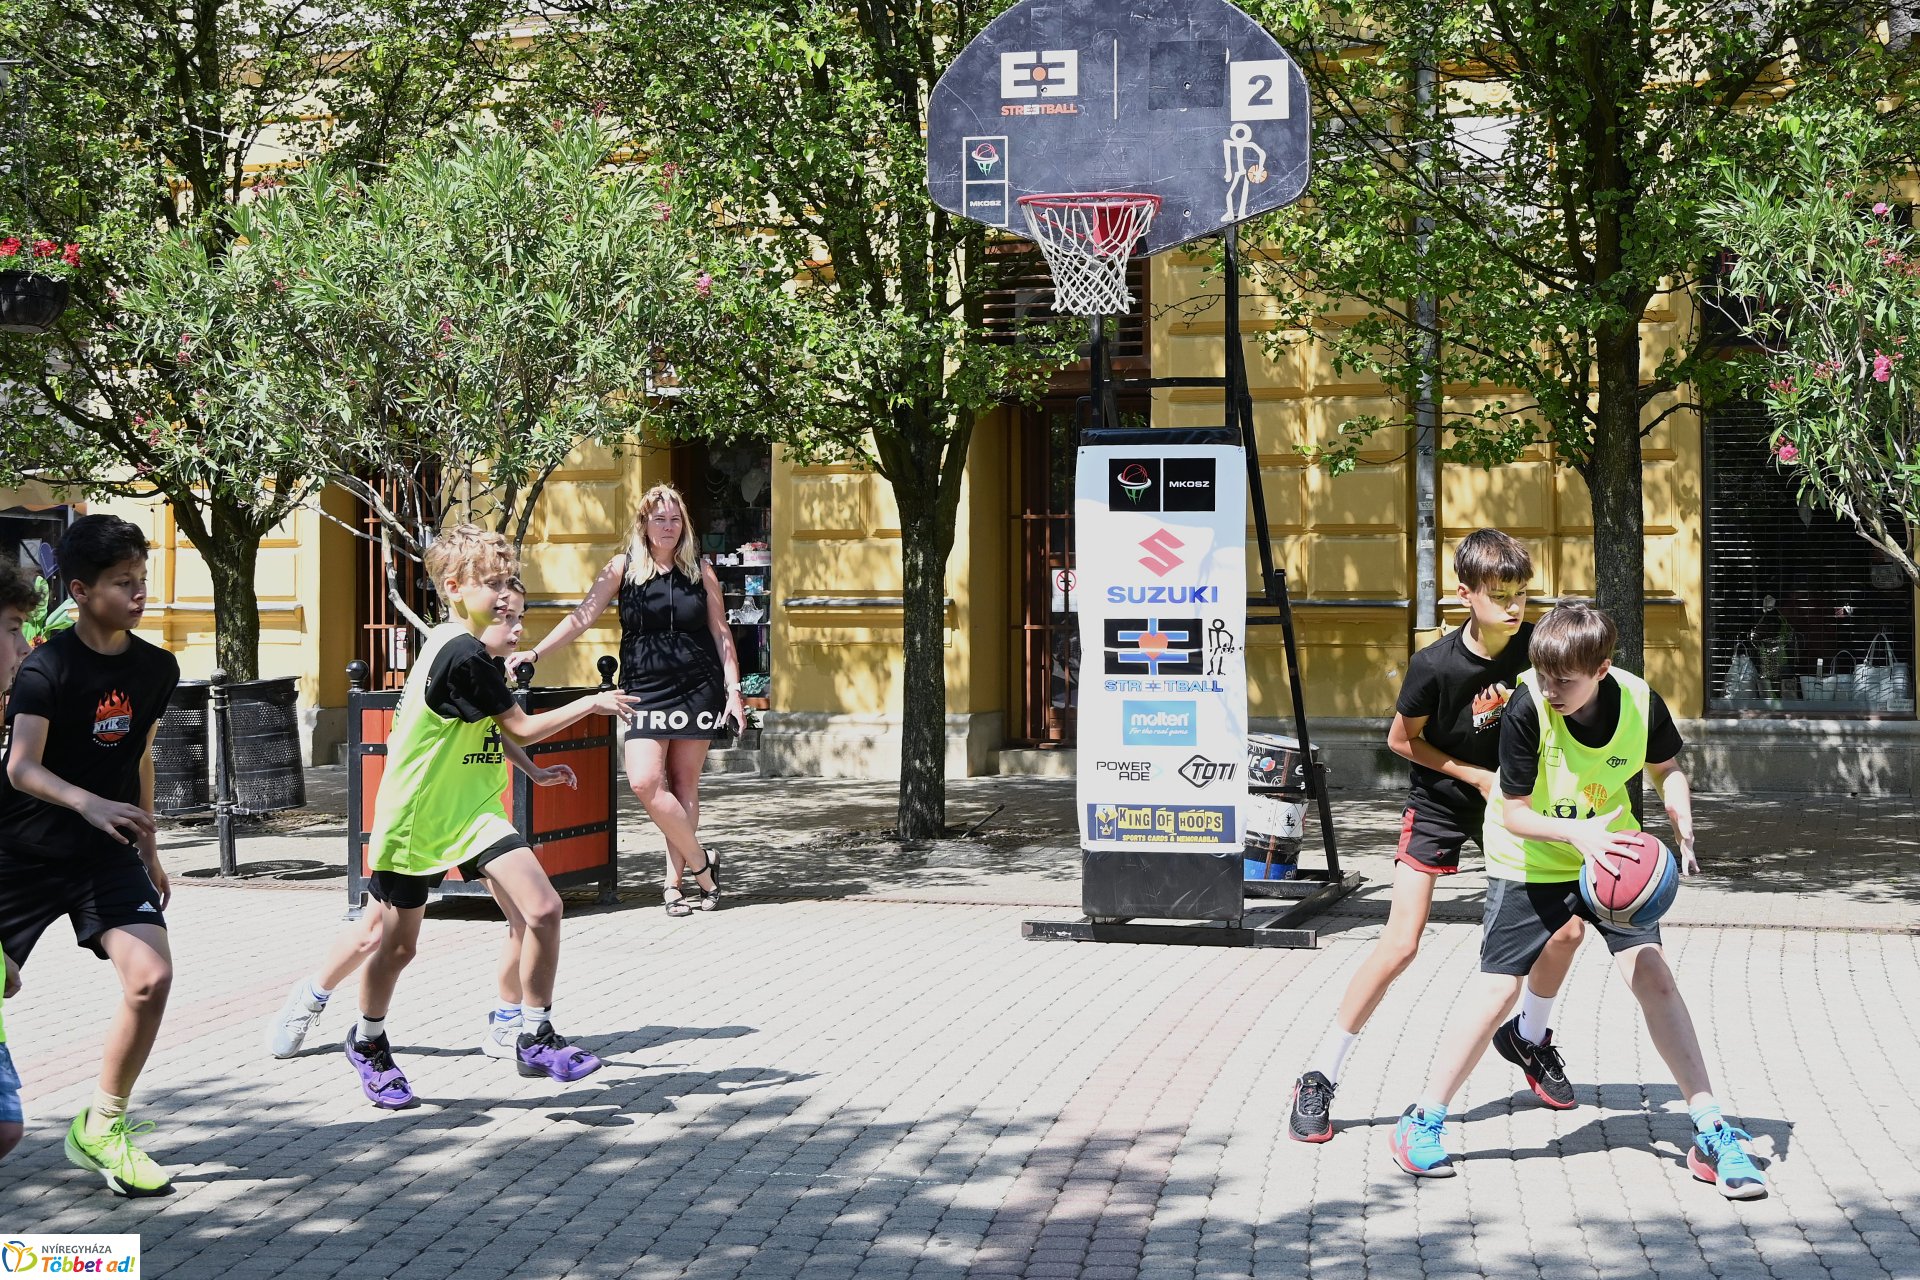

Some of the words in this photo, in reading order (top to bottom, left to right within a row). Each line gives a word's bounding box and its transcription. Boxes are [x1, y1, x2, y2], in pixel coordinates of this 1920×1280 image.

[1248, 74, 1273, 106] 2
[1169, 480, 1210, 488] MKOSZ
[1106, 586, 1218, 604] SUZUKI
[1131, 711, 1190, 726] molten
[1129, 727, 1142, 735] For
[1141, 727, 1153, 735] the
[1153, 727, 1169, 735] real
[1168, 729, 1189, 737] game
[1096, 761, 1151, 771] POWER
[1191, 762, 1238, 781] TOTI
[1118, 771, 1150, 781] ADE
[1119, 810, 1151, 828] KING
[1157, 813, 1173, 827] OF
[1180, 815, 1223, 829] HOOPS
[1122, 834, 1146, 842] SPORTS
[1148, 834, 1168, 842] CARDS
